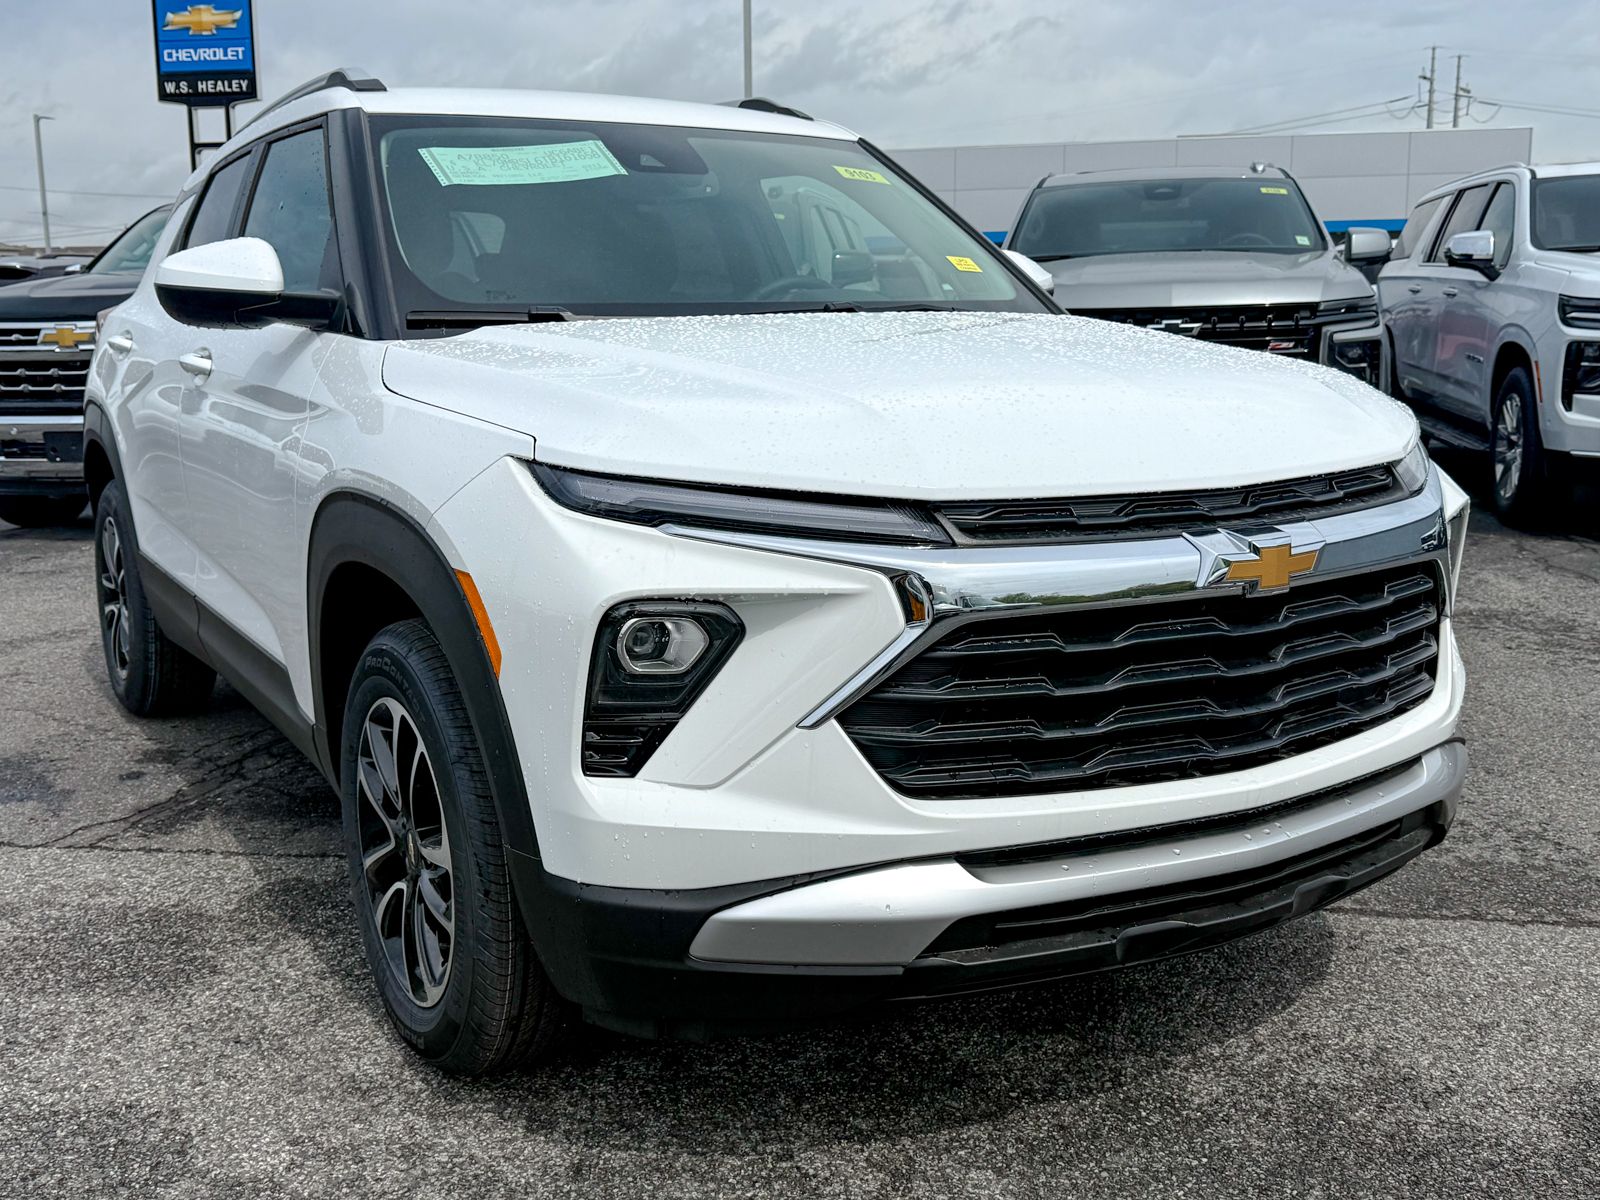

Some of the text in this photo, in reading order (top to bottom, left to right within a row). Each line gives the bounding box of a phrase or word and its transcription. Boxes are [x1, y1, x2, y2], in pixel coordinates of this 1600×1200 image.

[163, 47, 245, 62] CHEVROLET
[164, 79, 248, 94] W.S. HEALEY
